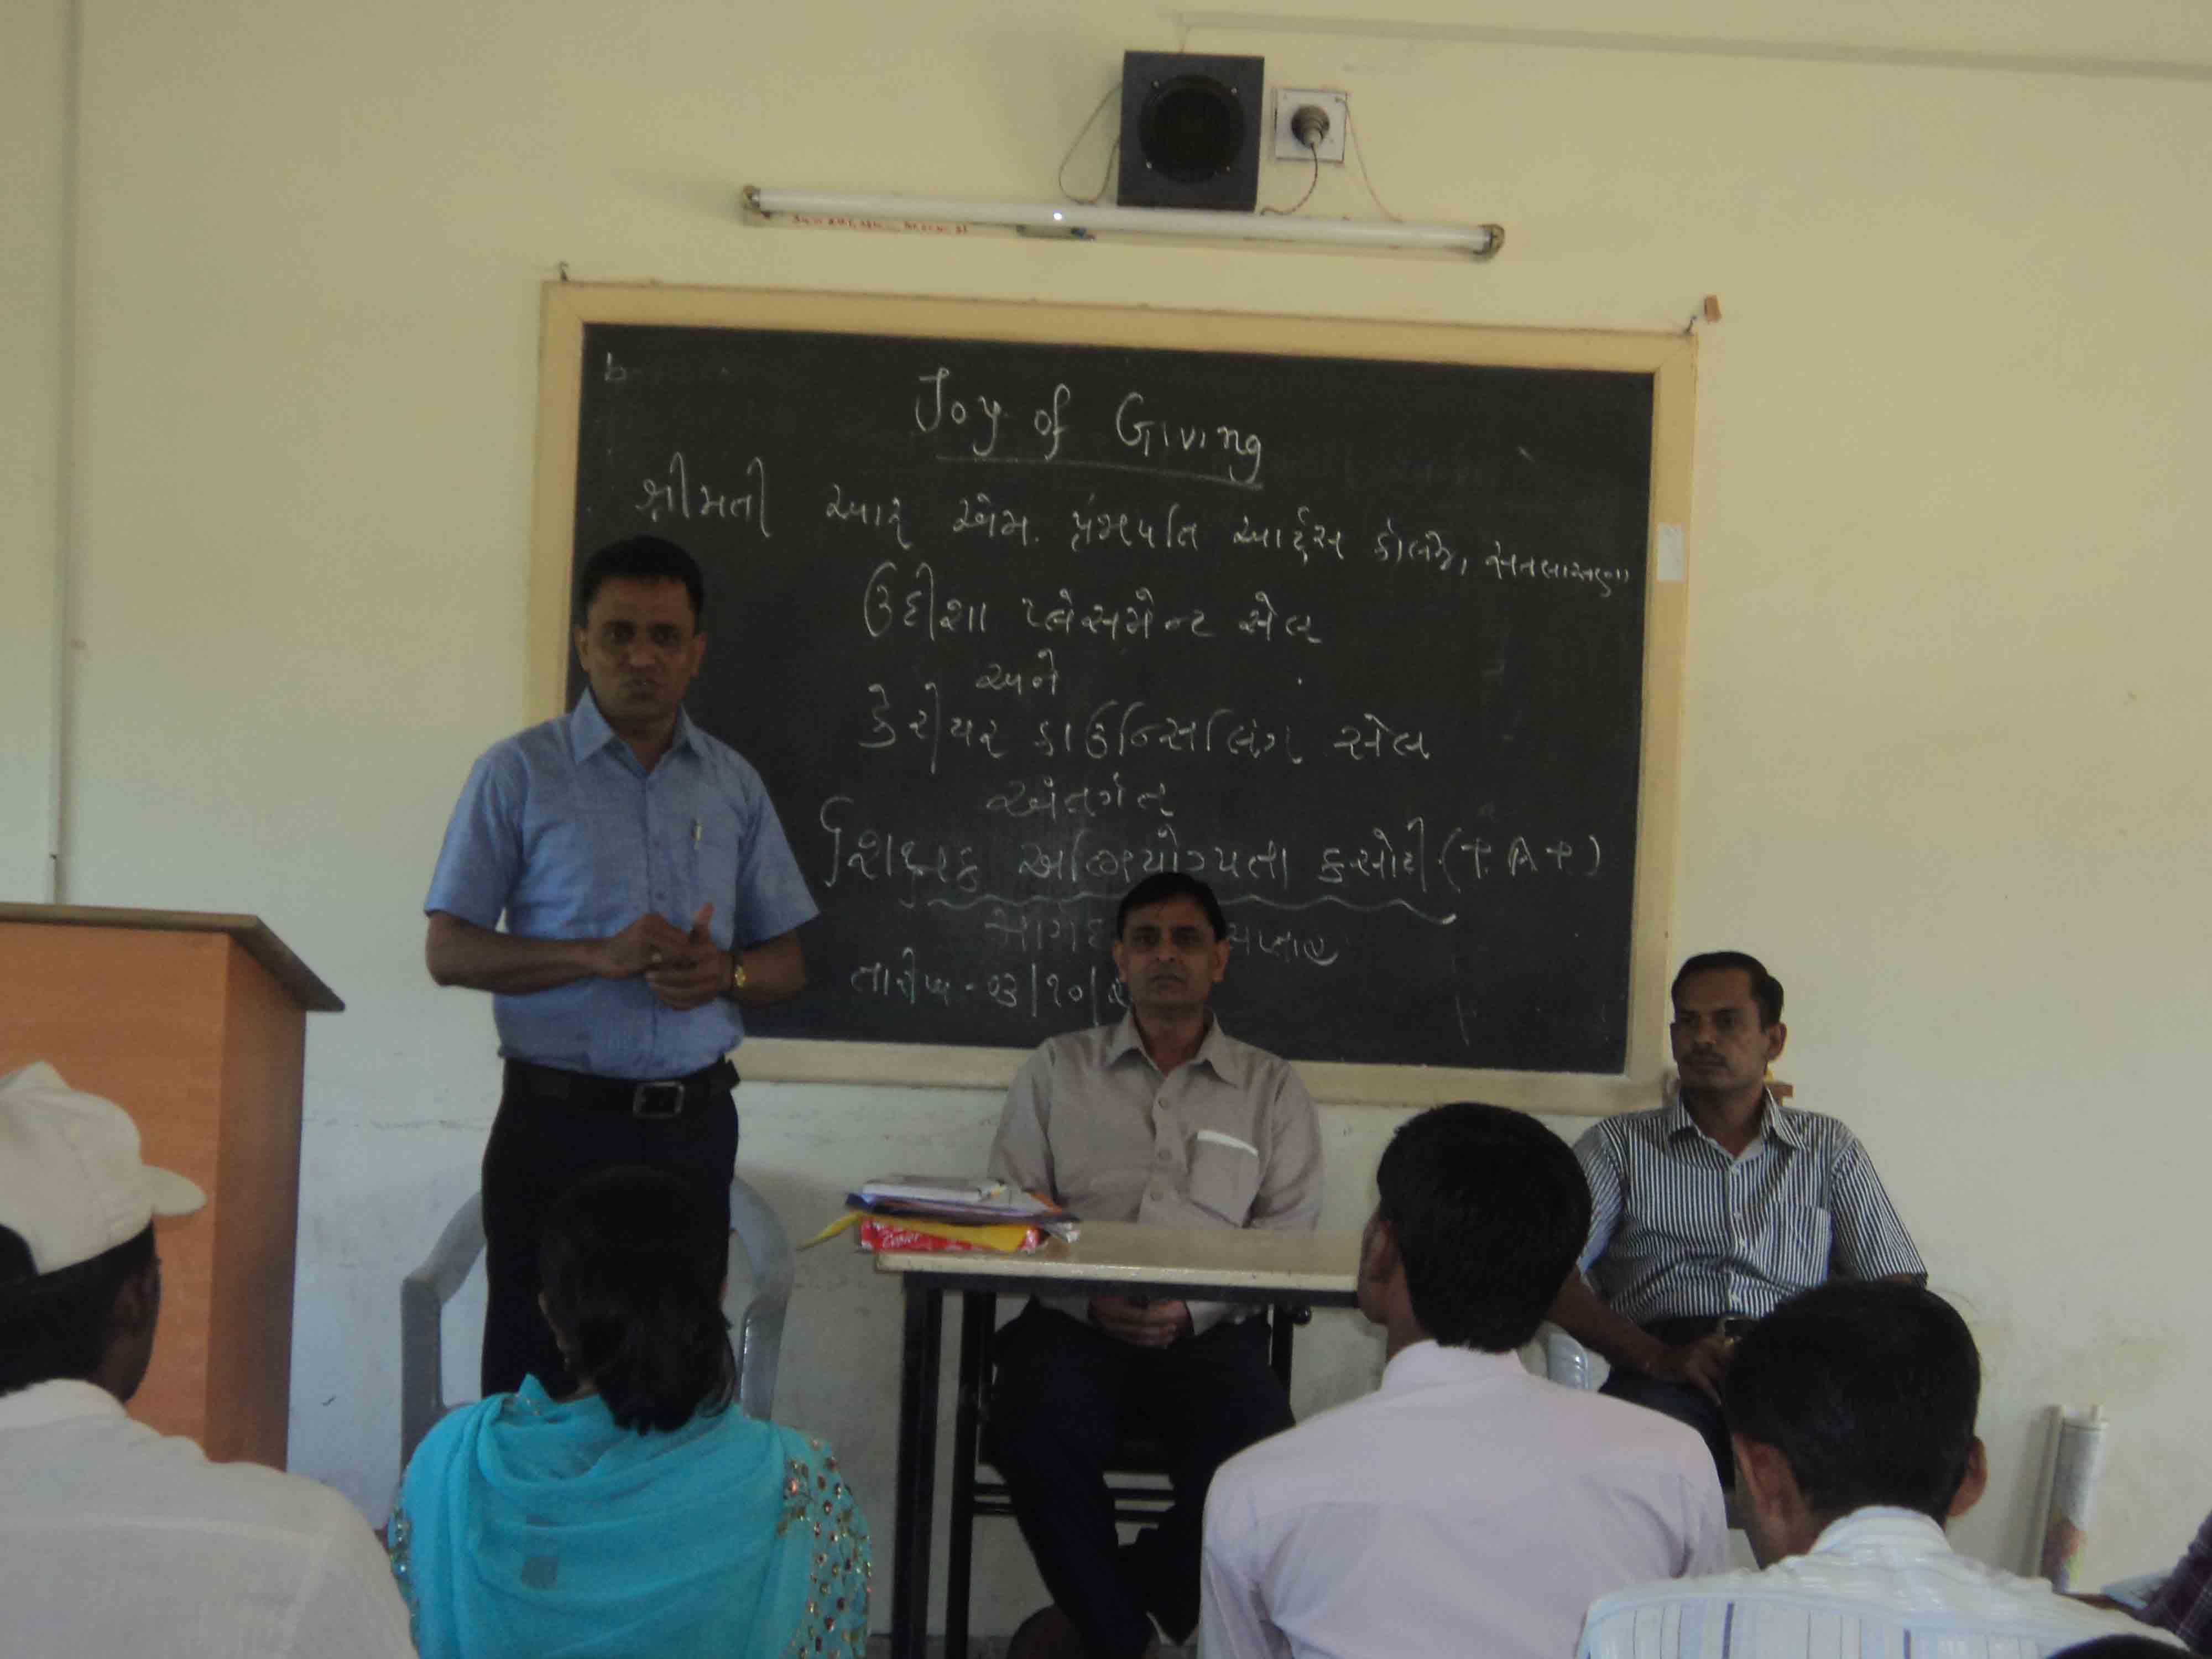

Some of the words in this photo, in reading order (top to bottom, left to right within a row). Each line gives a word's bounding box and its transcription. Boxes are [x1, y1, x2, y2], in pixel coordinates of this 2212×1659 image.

[915, 367, 1001, 456] Joy
[1034, 383, 1071, 461] of
[1115, 392, 1262, 483] Giving
[635, 451, 773, 538] શ્રીમતી
[975, 648, 1060, 696] અને
